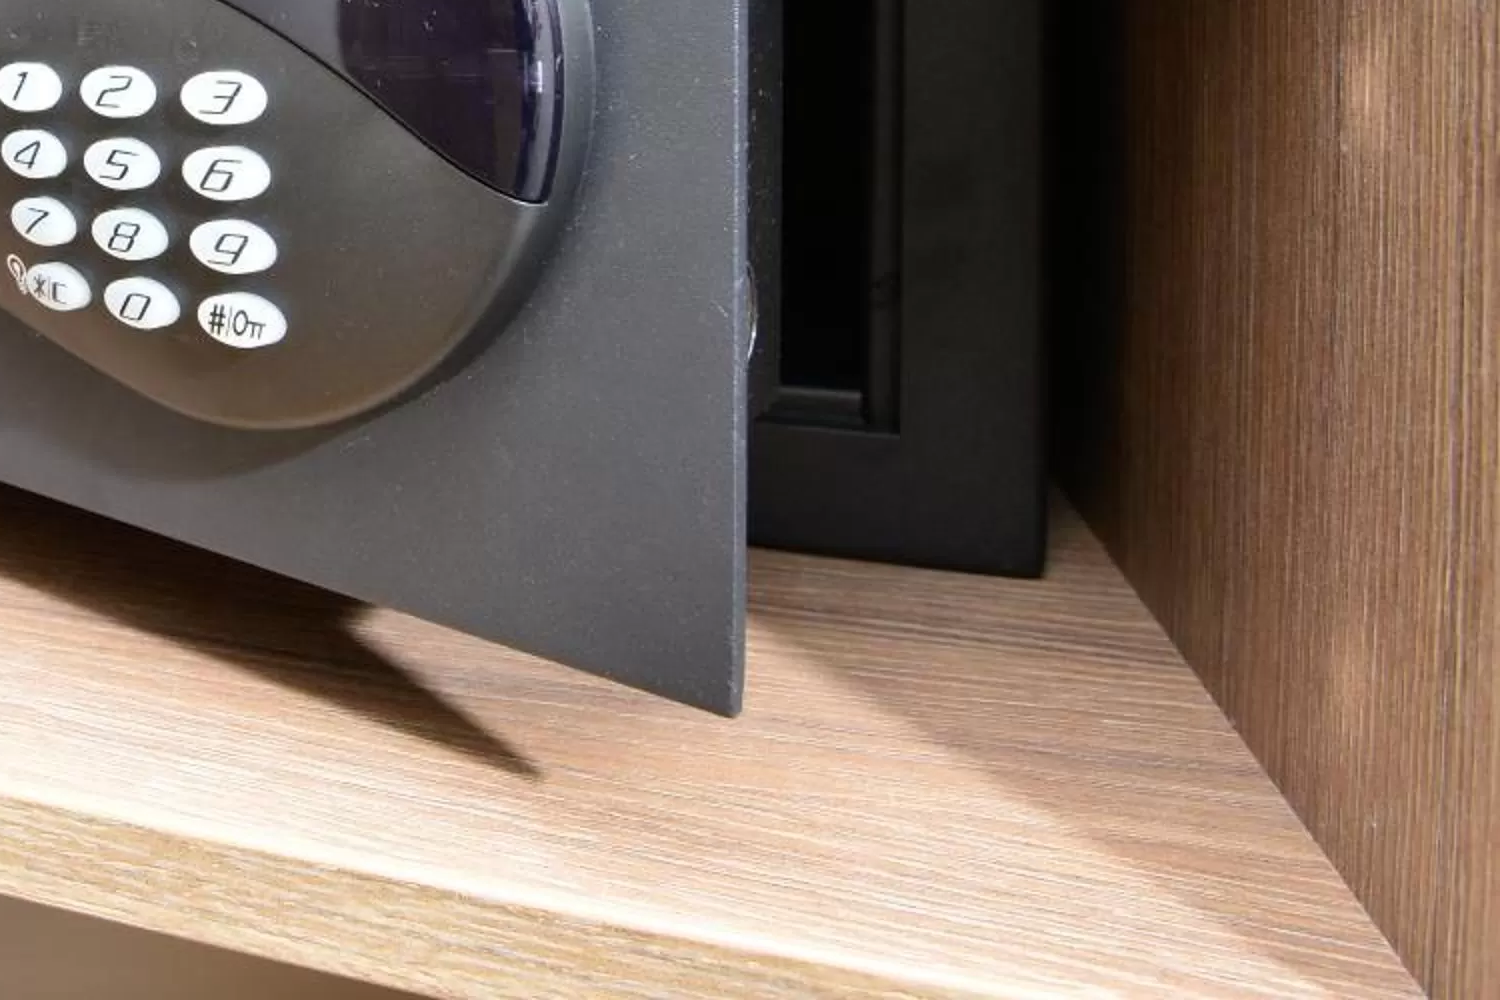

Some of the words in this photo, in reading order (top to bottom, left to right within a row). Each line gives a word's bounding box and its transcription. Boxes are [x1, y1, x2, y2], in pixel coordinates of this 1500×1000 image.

[11, 71, 29, 102] 1
[95, 74, 133, 108] 2
[198, 79, 243, 115] 3
[13, 139, 42, 170] 4
[98, 149, 140, 181] 5
[199, 158, 244, 193] 6
[25, 206, 50, 235] 7
[107, 221, 141, 253] 8
[206, 232, 250, 266] 9
[119, 293, 152, 321] 0
